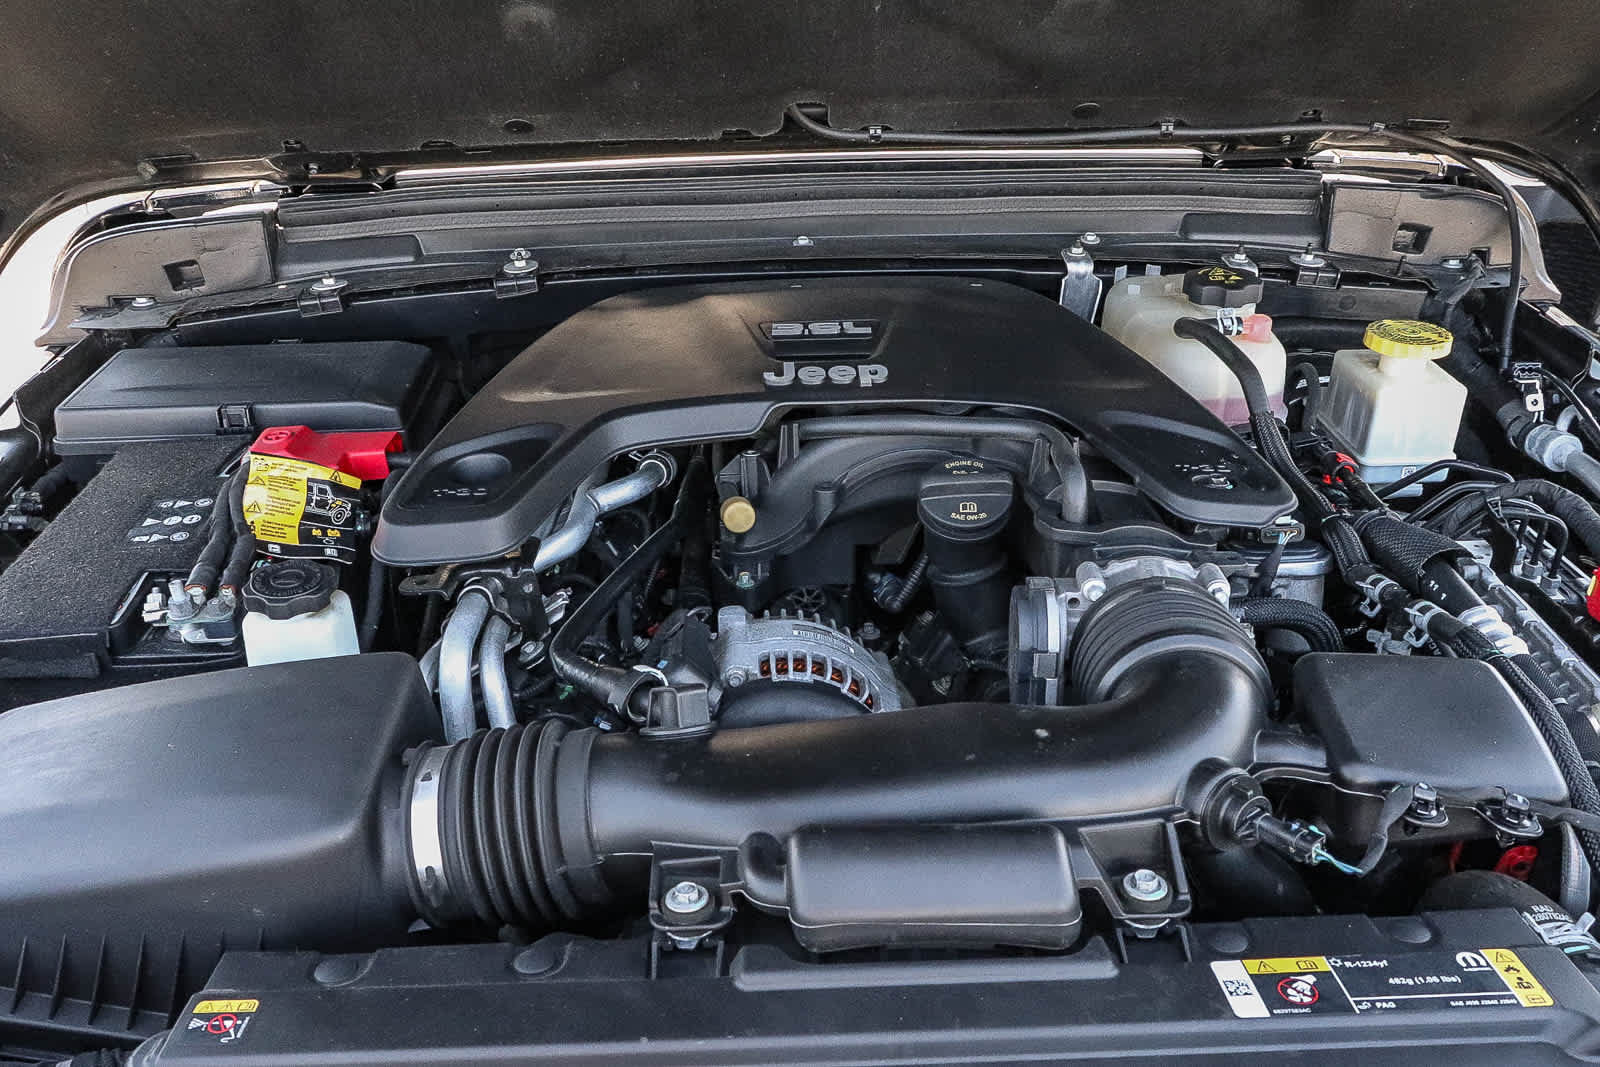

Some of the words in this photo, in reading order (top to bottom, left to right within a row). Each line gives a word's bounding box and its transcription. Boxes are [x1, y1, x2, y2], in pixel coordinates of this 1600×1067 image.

[772, 321, 872, 336] 3.6L
[763, 361, 889, 387] Jeep
[945, 460, 972, 469] ENGINE
[973, 461, 984, 469] OIL
[951, 512, 966, 520] SAE
